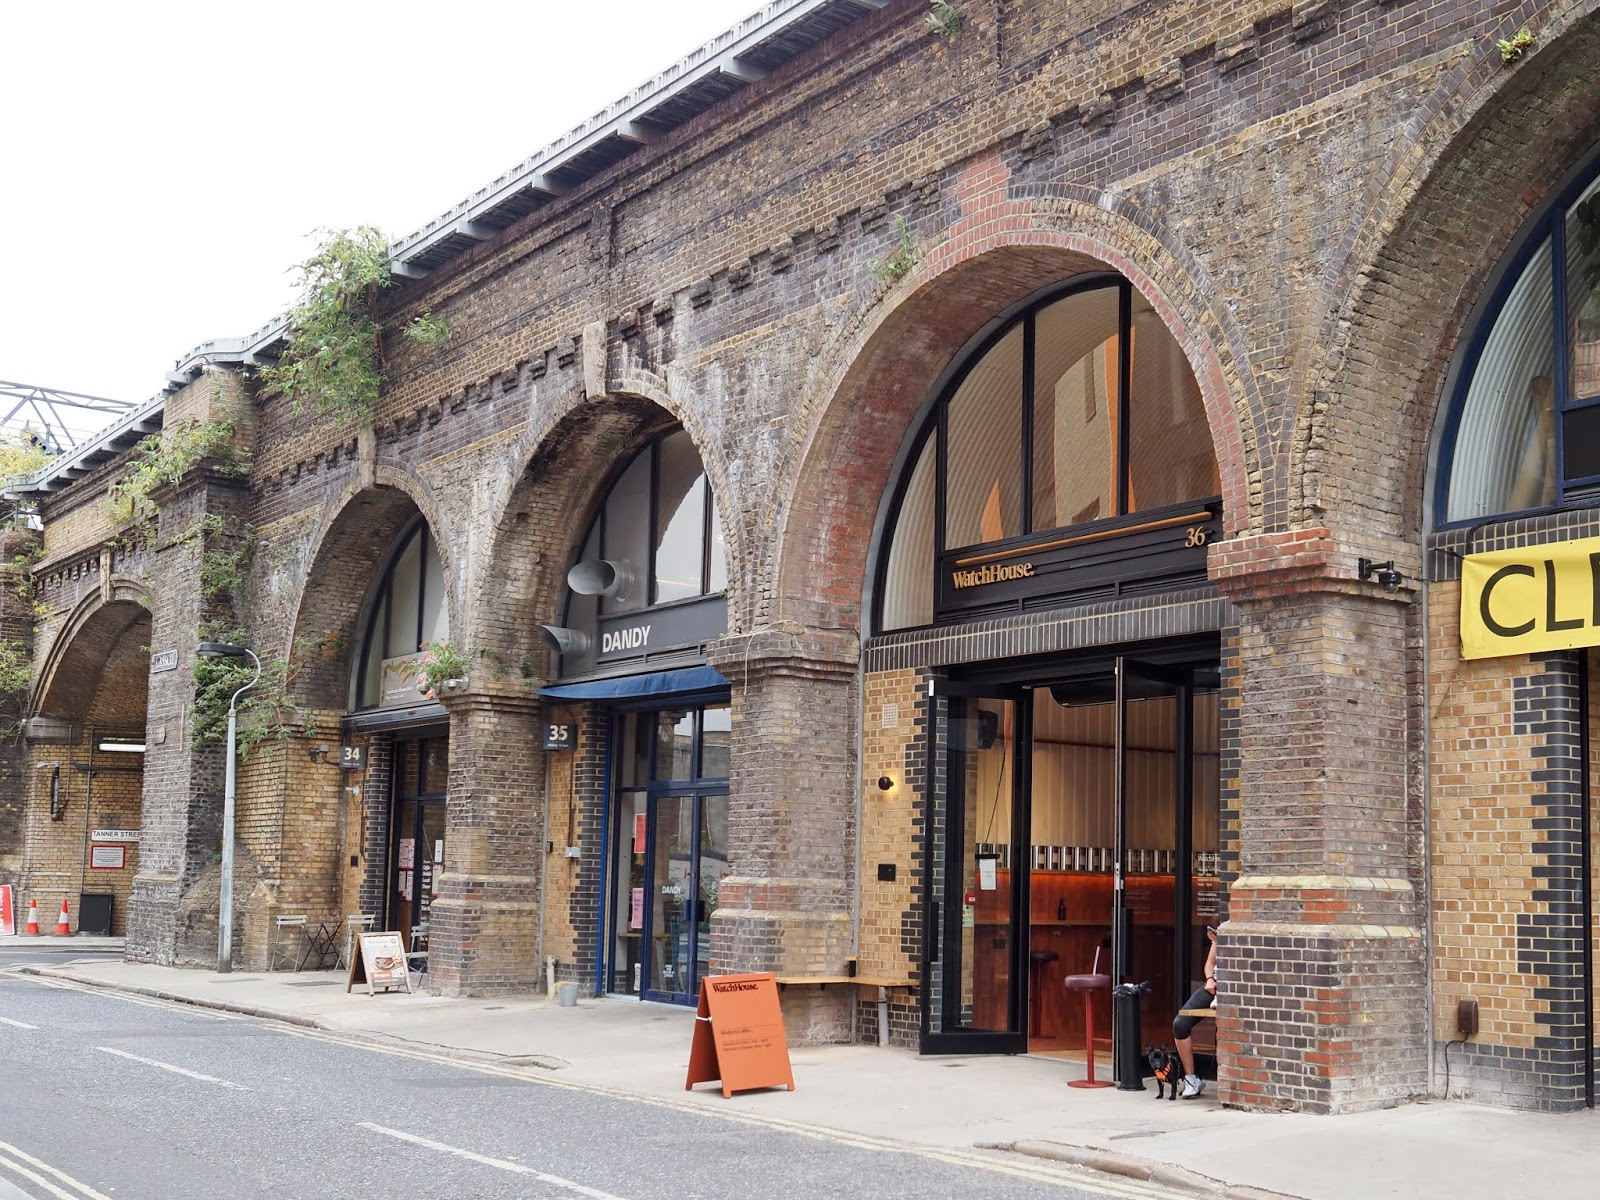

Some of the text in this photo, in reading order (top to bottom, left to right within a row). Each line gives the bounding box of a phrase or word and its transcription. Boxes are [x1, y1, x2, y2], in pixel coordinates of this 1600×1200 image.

[1185, 525, 1205, 548] 36
[953, 562, 1036, 589] WatchHouse.
[602, 625, 651, 653] DANDY
[549, 724, 568, 741] 35
[344, 747, 360, 760] 34
[661, 885, 682, 894] DANDY
[712, 983, 759, 993] WatchHouse.
